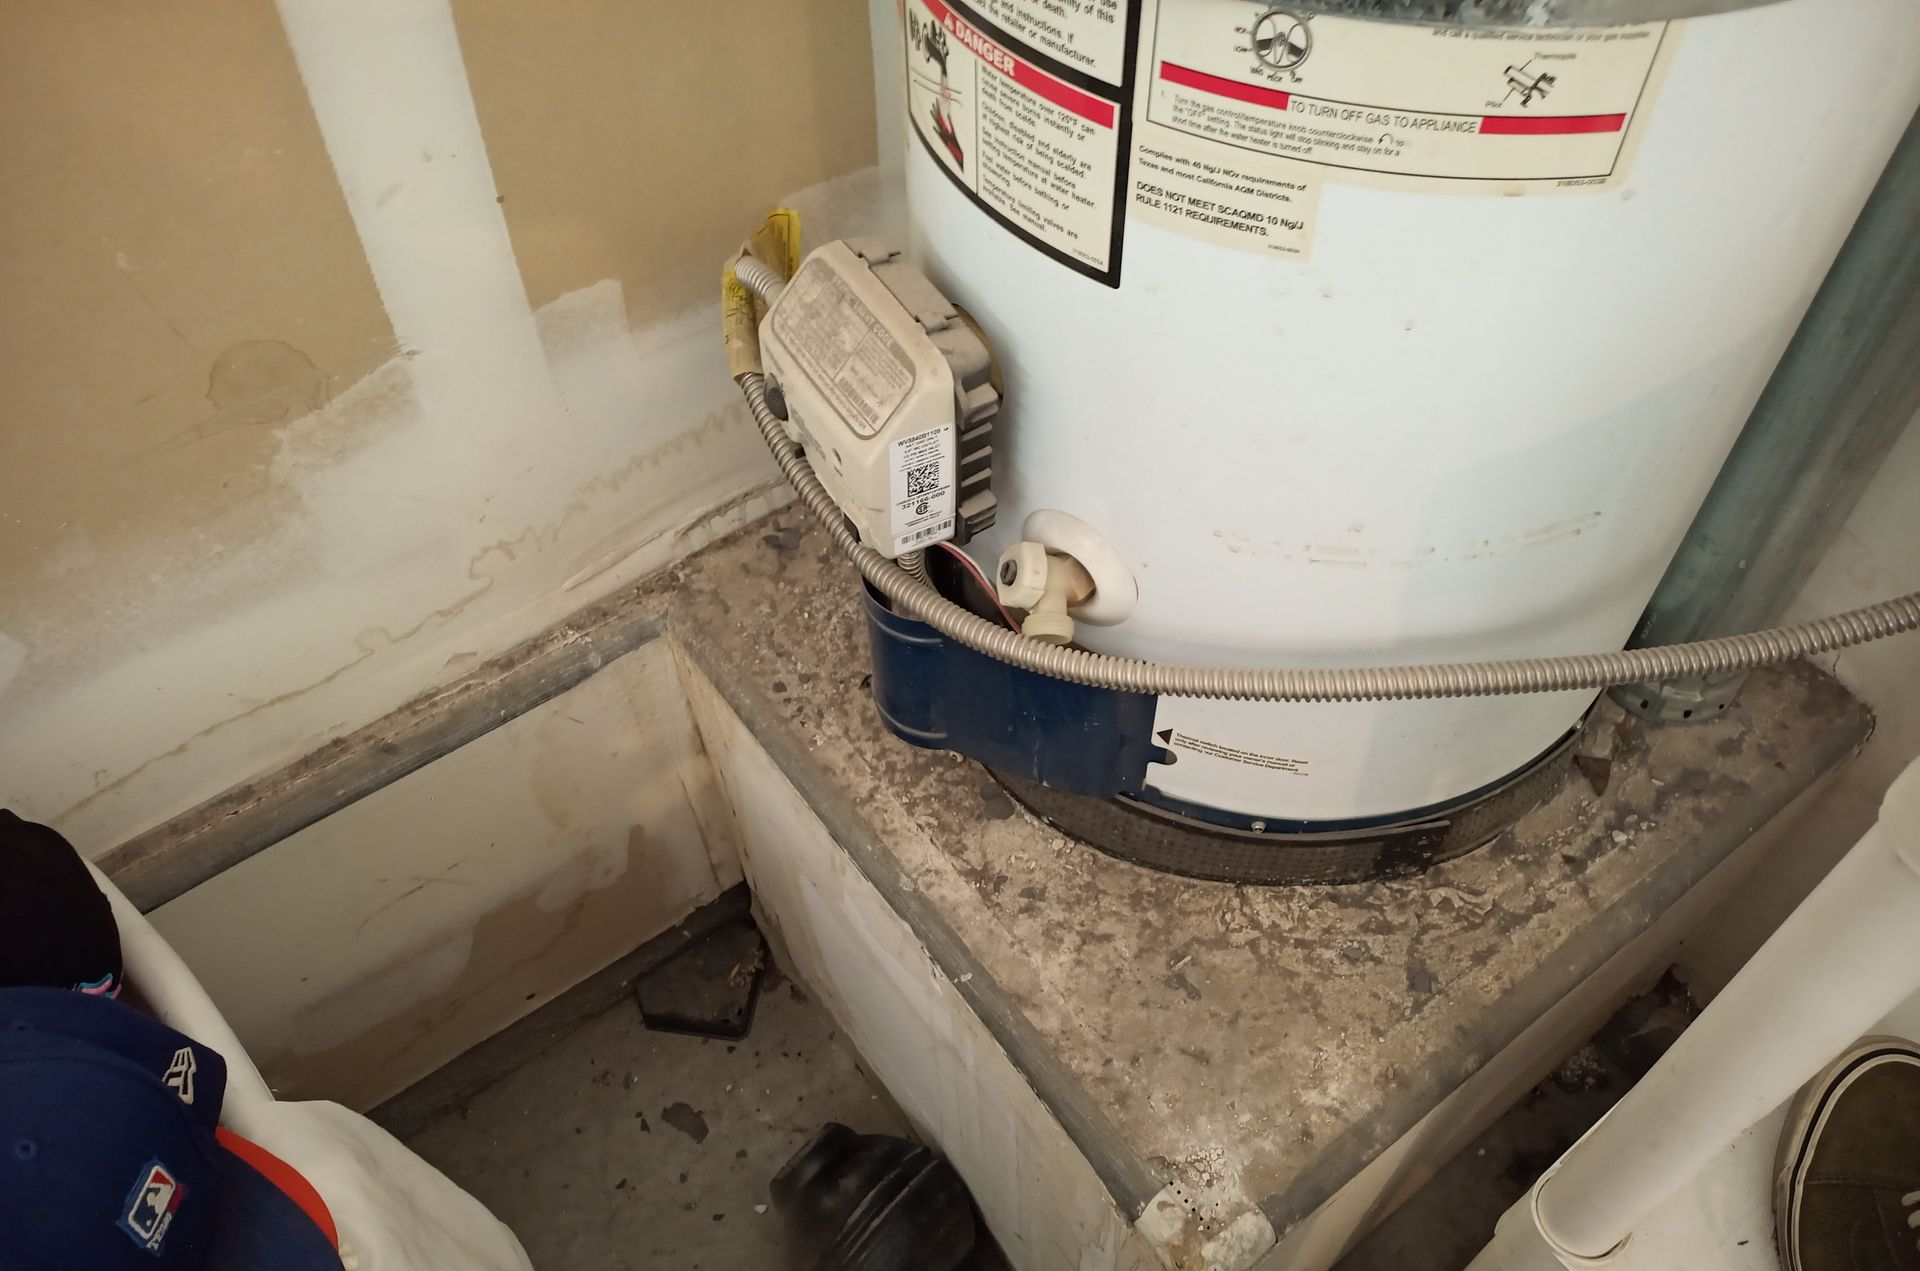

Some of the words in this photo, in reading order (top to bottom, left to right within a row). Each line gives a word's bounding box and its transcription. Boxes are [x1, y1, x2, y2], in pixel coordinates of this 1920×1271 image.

[1084, 4, 1094, 16] of
[1097, 8, 1114, 24] this
[955, 20, 1016, 77] DANGER
[1028, 29, 1037, 39] or
[1040, 35, 1096, 68] manufacturer.
[1044, 117, 1074, 138] instantly
[1081, 124, 1095, 135] can
[1191, 99, 1201, 109] the
[1202, 104, 1215, 112] gas
[1289, 124, 1307, 134] knob
[1309, 127, 1374, 144] counterclockwise
[1290, 100, 1305, 113] TO
[1308, 104, 1338, 119] TURN
[1341, 109, 1362, 122] OFF
[1365, 113, 1390, 127] GAS
[1394, 116, 1410, 129] TO
[1411, 118, 1478, 133] APPLIANCE
[1203, 125, 1217, 134] after
[1219, 128, 1229, 137] the
[1231, 132, 1248, 142] water
[1250, 136, 1271, 147] heater
[1272, 141, 1278, 149] is
[1234, 120, 1246, 130] The
[1248, 124, 1268, 136] status
[1269, 129, 1284, 140] light
[1285, 133, 1297, 141] will
[1298, 134, 1312, 145] stop
[1313, 138, 1340, 151] blinking
[1342, 142, 1355, 151] and
[1356, 144, 1371, 155] stay
[1383, 148, 1393, 157] for
[1026, 142, 1033, 150] of
[1035, 148, 1053, 165] being
[1038, 139, 1050, 150] and
[1053, 147, 1077, 166] elderly
[1080, 162, 1091, 171] are
[1138, 145, 1173, 162] Complies
[1175, 157, 1190, 168] with
[1193, 161, 1201, 169] 40
[1203, 163, 1220, 175] Ng/J
[1241, 174, 1295, 191] requirements
[1297, 184, 1307, 192] of
[1002, 152, 1038, 179] temperature
[1050, 182, 1069, 195] water
[1027, 159, 1051, 176] manual
[1054, 174, 1076, 189] before
[1138, 157, 1159, 170] Texas
[1161, 165, 1174, 175] and
[1175, 171, 1195, 181] most
[1196, 175, 1233, 191] California
[1256, 189, 1292, 202] Districts.
[1034, 188, 1059, 207] bathing
[1136, 181, 1163, 197] DOES
[1164, 190, 1186, 204] NOT
[1187, 197, 1216, 212] MEET
[1217, 205, 1264, 222] SCAQMD
[1266, 216, 1278, 226] 10
[1279, 219, 1304, 231] Ng/J
[1043, 218, 1064, 232] valves
[1067, 230, 1078, 239] are
[1135, 193, 1161, 209] RULE
[1163, 202, 1183, 215] 1121
[1185, 209, 1269, 237] REQUIREMENTS.
[1174, 742, 1203, 753] contacting
[1214, 752, 1241, 763] Customer
[1176, 732, 1199, 743] Thermal
[1200, 740, 1218, 749] switch
[1219, 744, 1240, 754] located
[1201, 744, 1228, 756] reviewing
[1243, 755, 1265, 763] owner's
